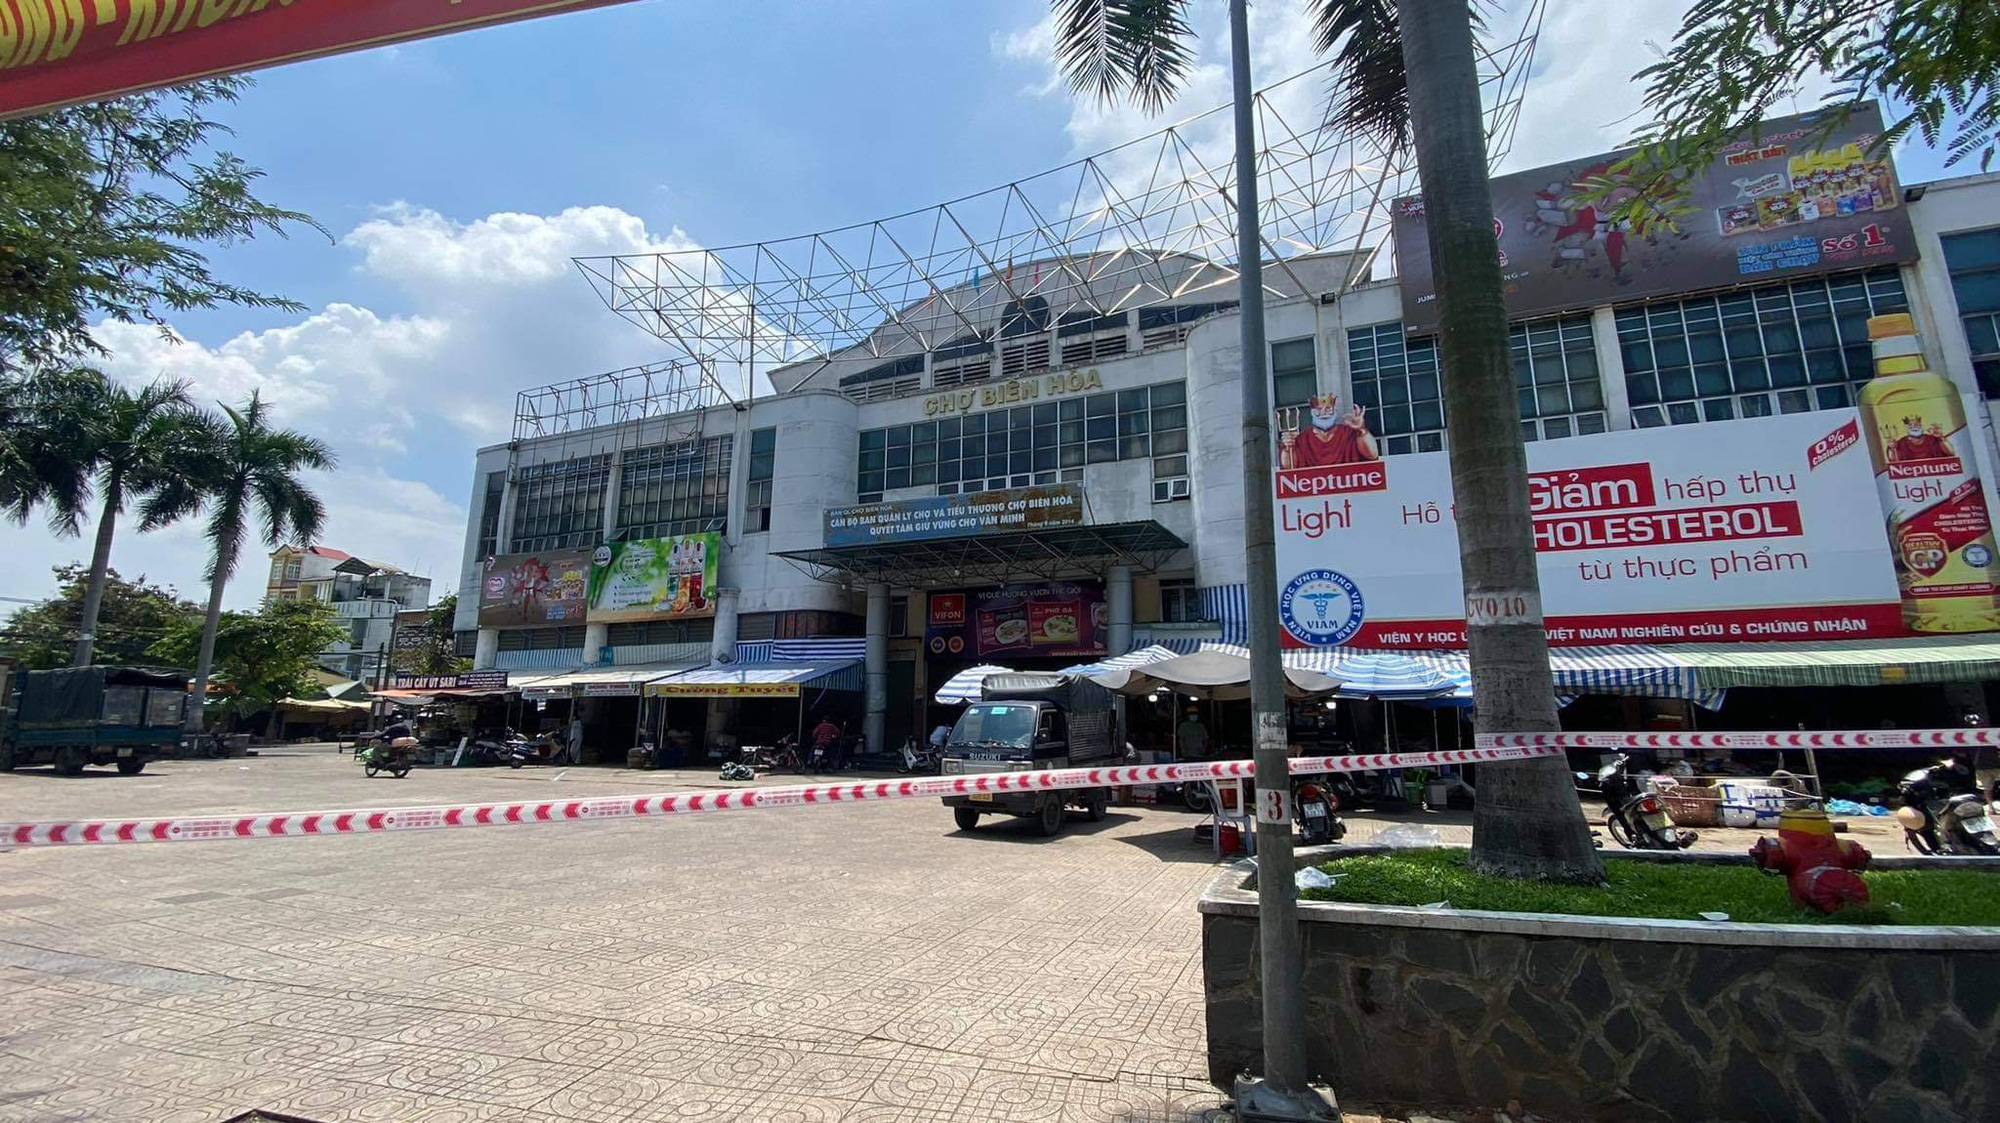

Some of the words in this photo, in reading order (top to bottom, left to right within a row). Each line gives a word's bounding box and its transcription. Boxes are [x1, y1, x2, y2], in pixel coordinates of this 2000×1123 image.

[1861, 223, 1886, 247] 1
[922, 388, 977, 416] CHỢ
[981, 378, 1040, 406] BIÊN
[1889, 462, 1960, 478] Neptune
[1279, 471, 1383, 495] Neptune
[1528, 472, 1639, 512] Giảm
[1664, 475, 1726, 503] hấp
[1738, 470, 1797, 495] thụ
[1894, 479, 1943, 503] Light
[1000, 512, 1025, 524] MINH
[1281, 499, 1352, 539] Light
[1402, 501, 1440, 525] Hỗ
[1532, 506, 1789, 549] HOLESTEROL
[1578, 559, 1612, 581] từ
[1623, 556, 1697, 580] thực
[1710, 546, 1808, 581] phẩm
[934, 610, 962, 620] VIFON
[1468, 596, 1526, 618] CV010
[1307, 620, 1339, 629] VIAM
[1543, 626, 1575, 642] VIỆT
[1579, 627, 1618, 640] NAM
[1621, 624, 1685, 638] NGHIÊN
[1689, 622, 1724, 636] CỨU
[1729, 623, 1742, 635] &
[1746, 619, 1809, 633] CHỨNG
[1813, 617, 1868, 633] NHẬN
[1378, 631, 1411, 645] VIỆN
[1413, 633, 1424, 643] Y
[1428, 632, 1457, 645] HỌC
[969, 752, 1001, 761] SUZUKI
[1267, 790, 1283, 821] 3
